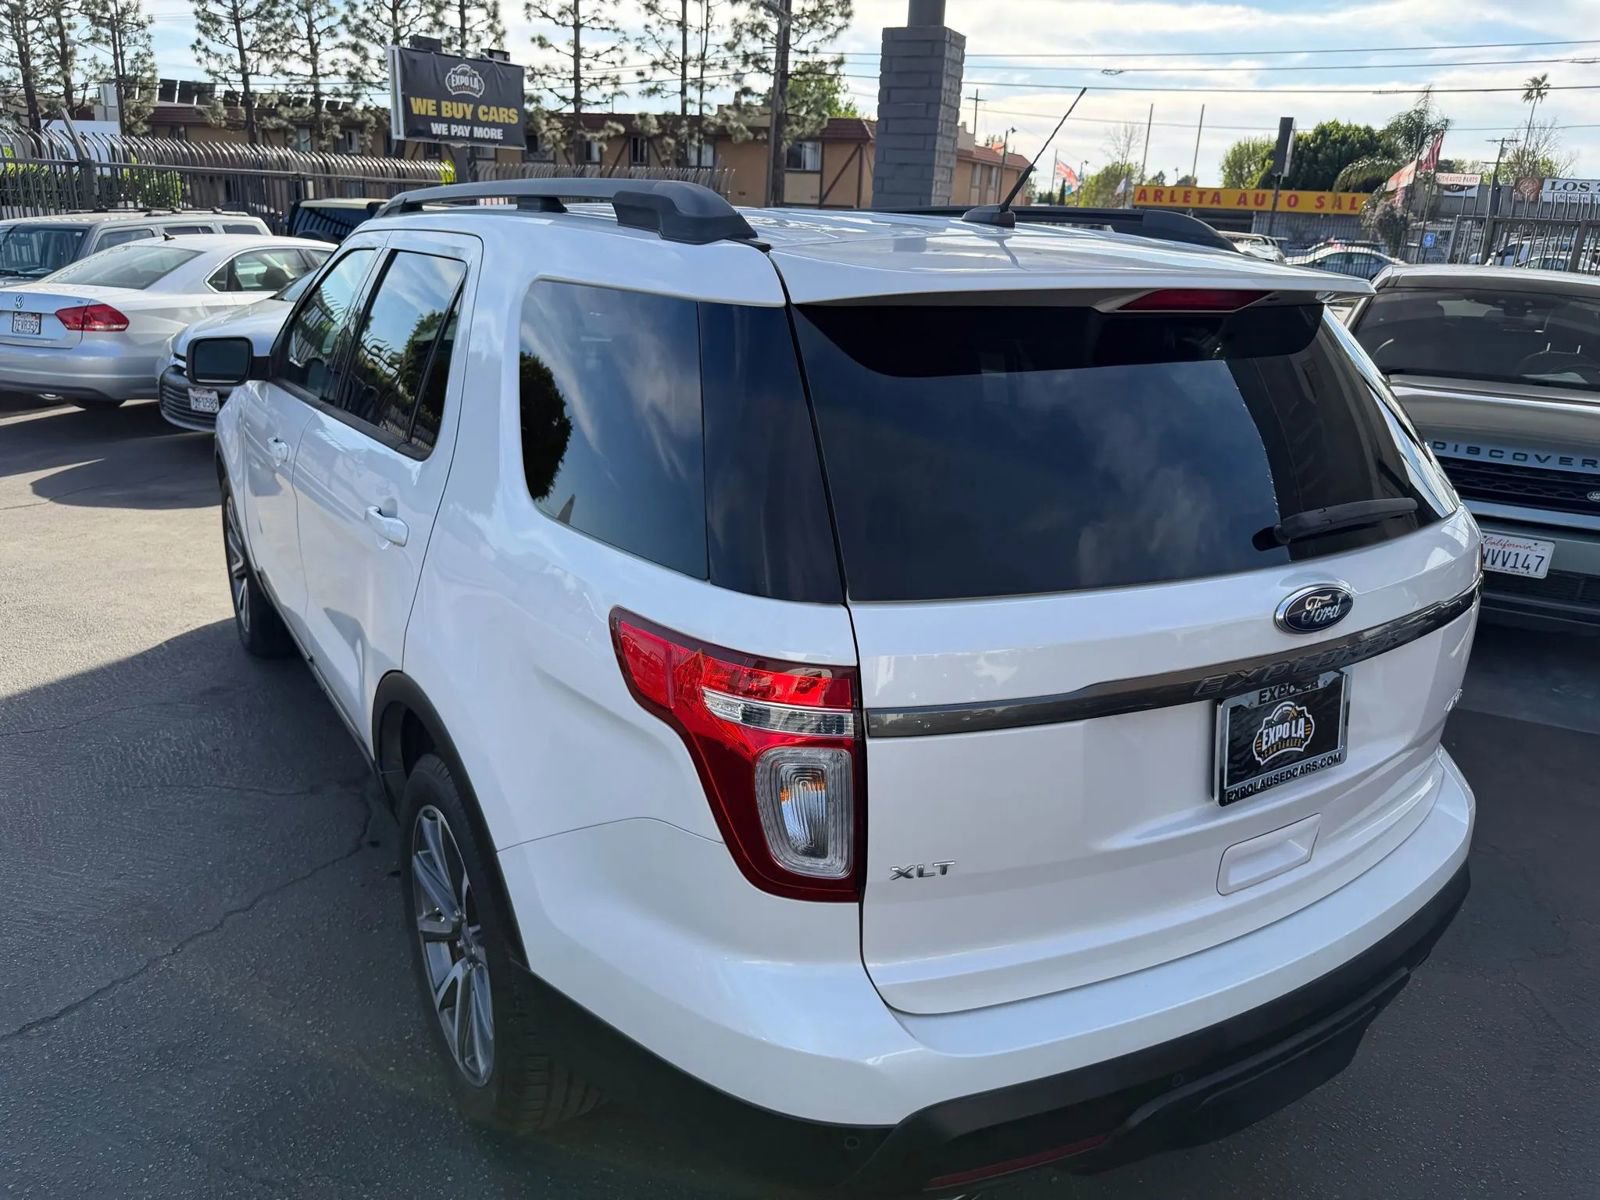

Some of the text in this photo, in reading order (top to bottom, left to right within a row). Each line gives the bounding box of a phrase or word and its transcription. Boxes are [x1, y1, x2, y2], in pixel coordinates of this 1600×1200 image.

[451, 74, 469, 87] EXPO
[470, 77, 480, 90] LA
[410, 97, 518, 124] WE BUY CARS
[431, 122, 503, 140] WE PAY MORE
[1549, 181, 1590, 192] LOS
[1137, 188, 1221, 205] ARLETA
[1237, 192, 1299, 208] AUO
[1485, 536, 1534, 551] California
[1301, 594, 1342, 624] Ford
[1262, 718, 1305, 752] EXPO LA
[1227, 753, 1342, 802] EXPOLAUSEDCARS.COM
[889, 860, 956, 880] XLT
